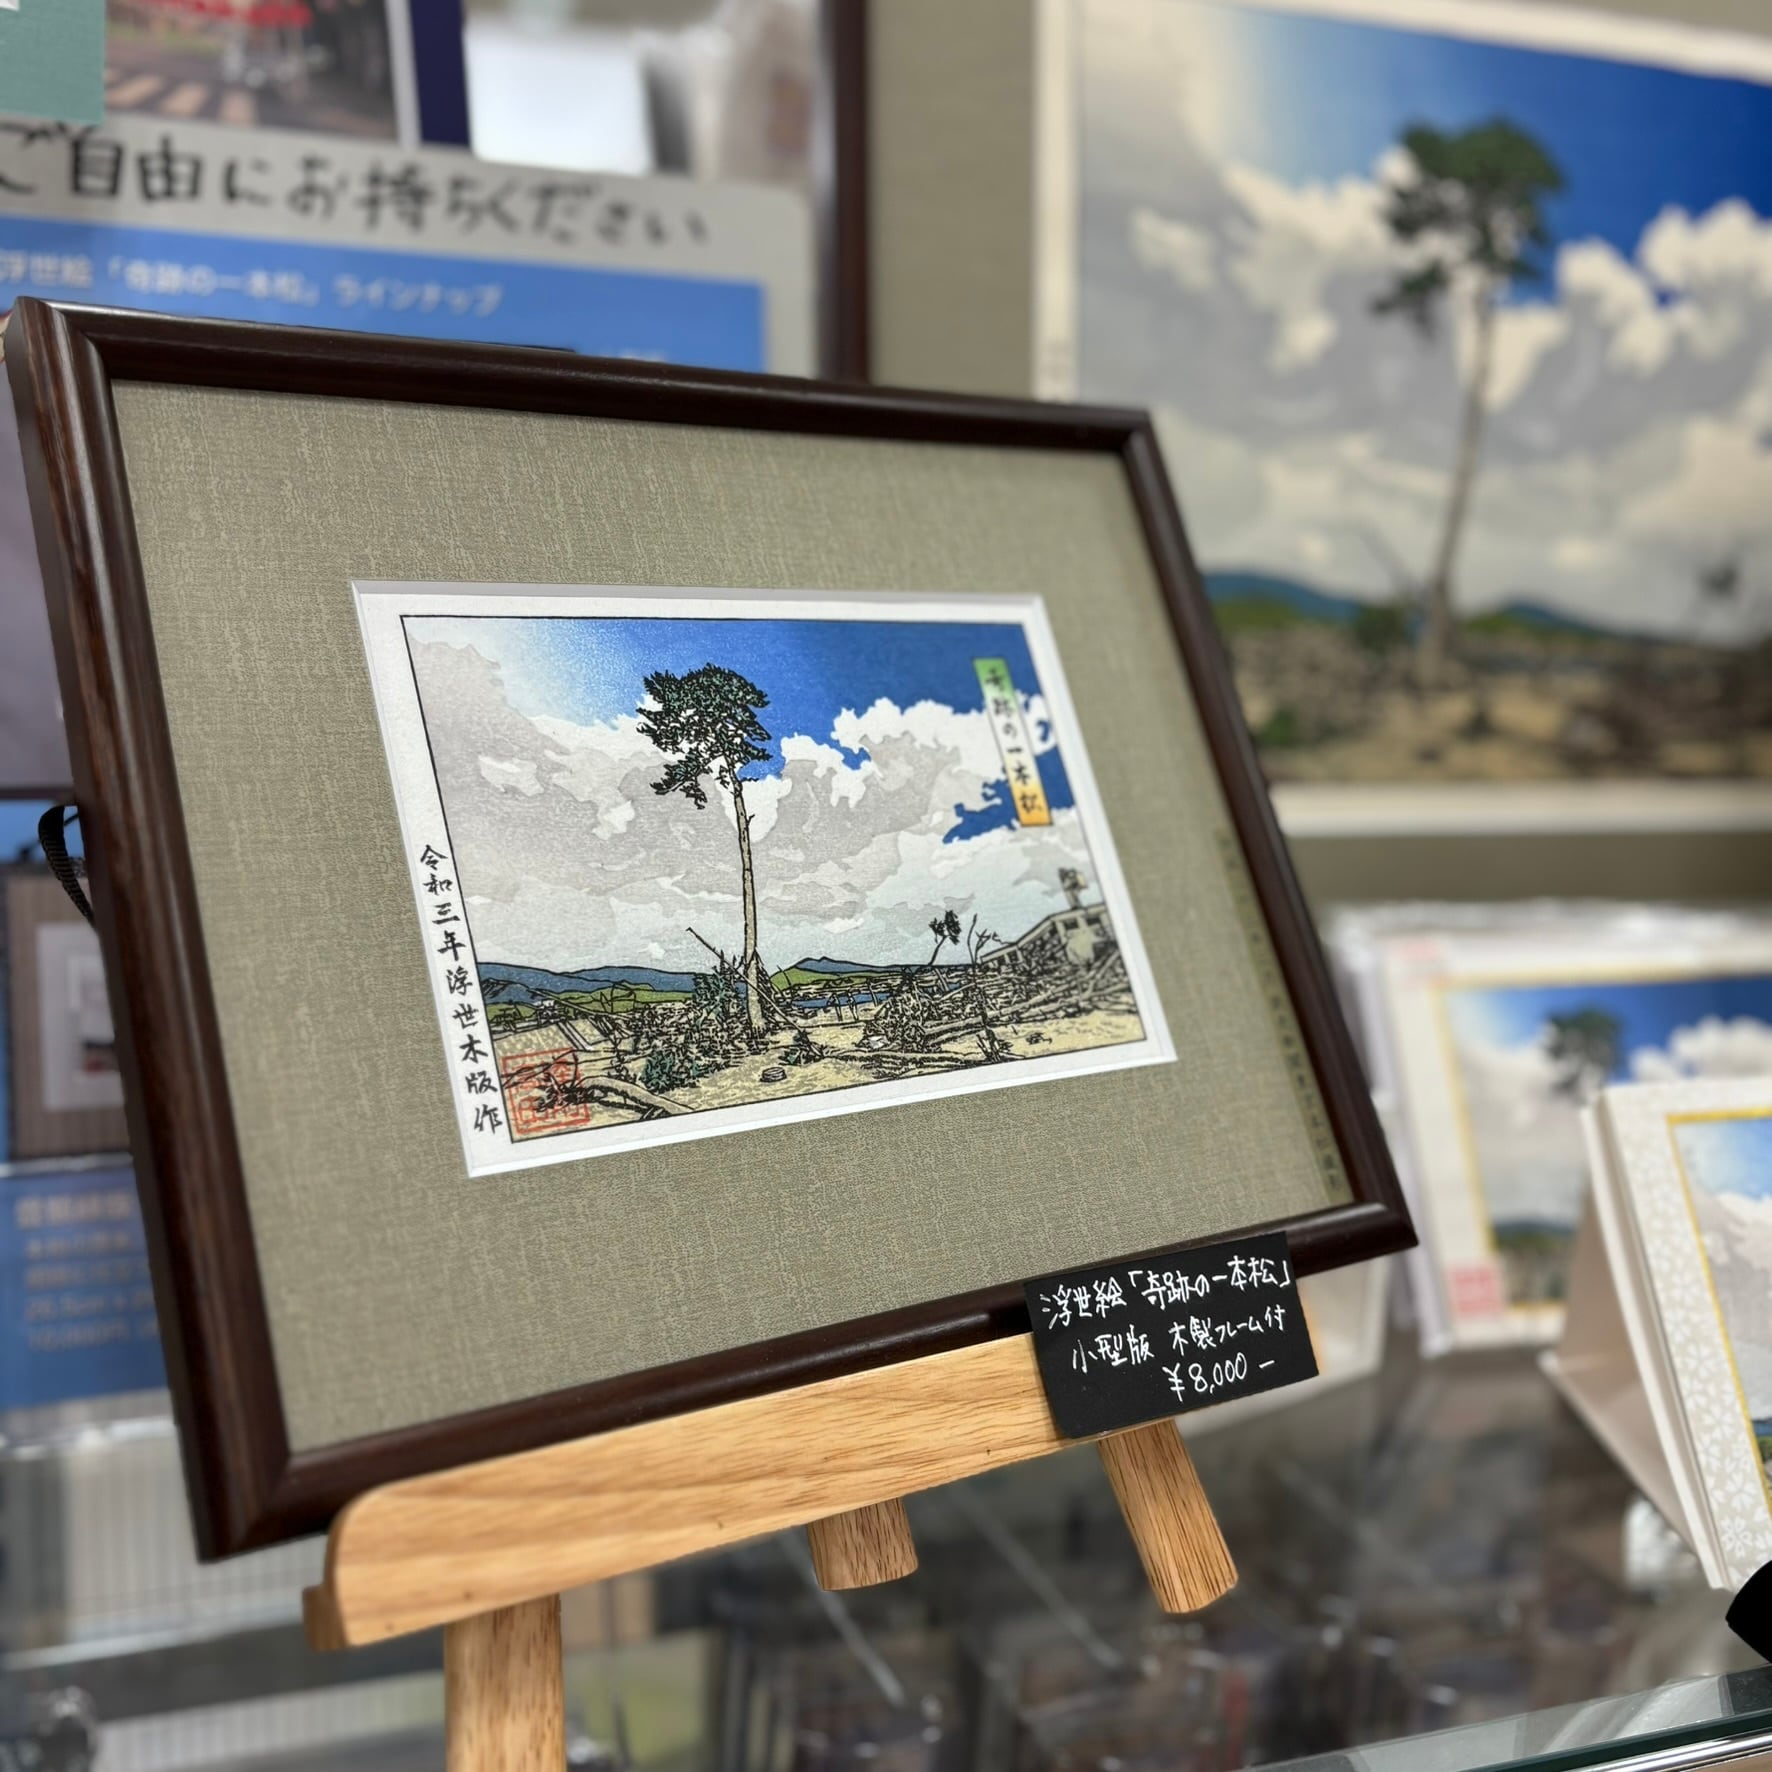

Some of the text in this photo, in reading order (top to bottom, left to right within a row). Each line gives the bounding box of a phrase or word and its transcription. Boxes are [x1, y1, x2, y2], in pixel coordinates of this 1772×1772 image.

[1039, 1254, 1292, 1330] 浮世絵「奇跡の一本松」
[1071, 1303, 1287, 1374] 小型版 木製フレーム付
